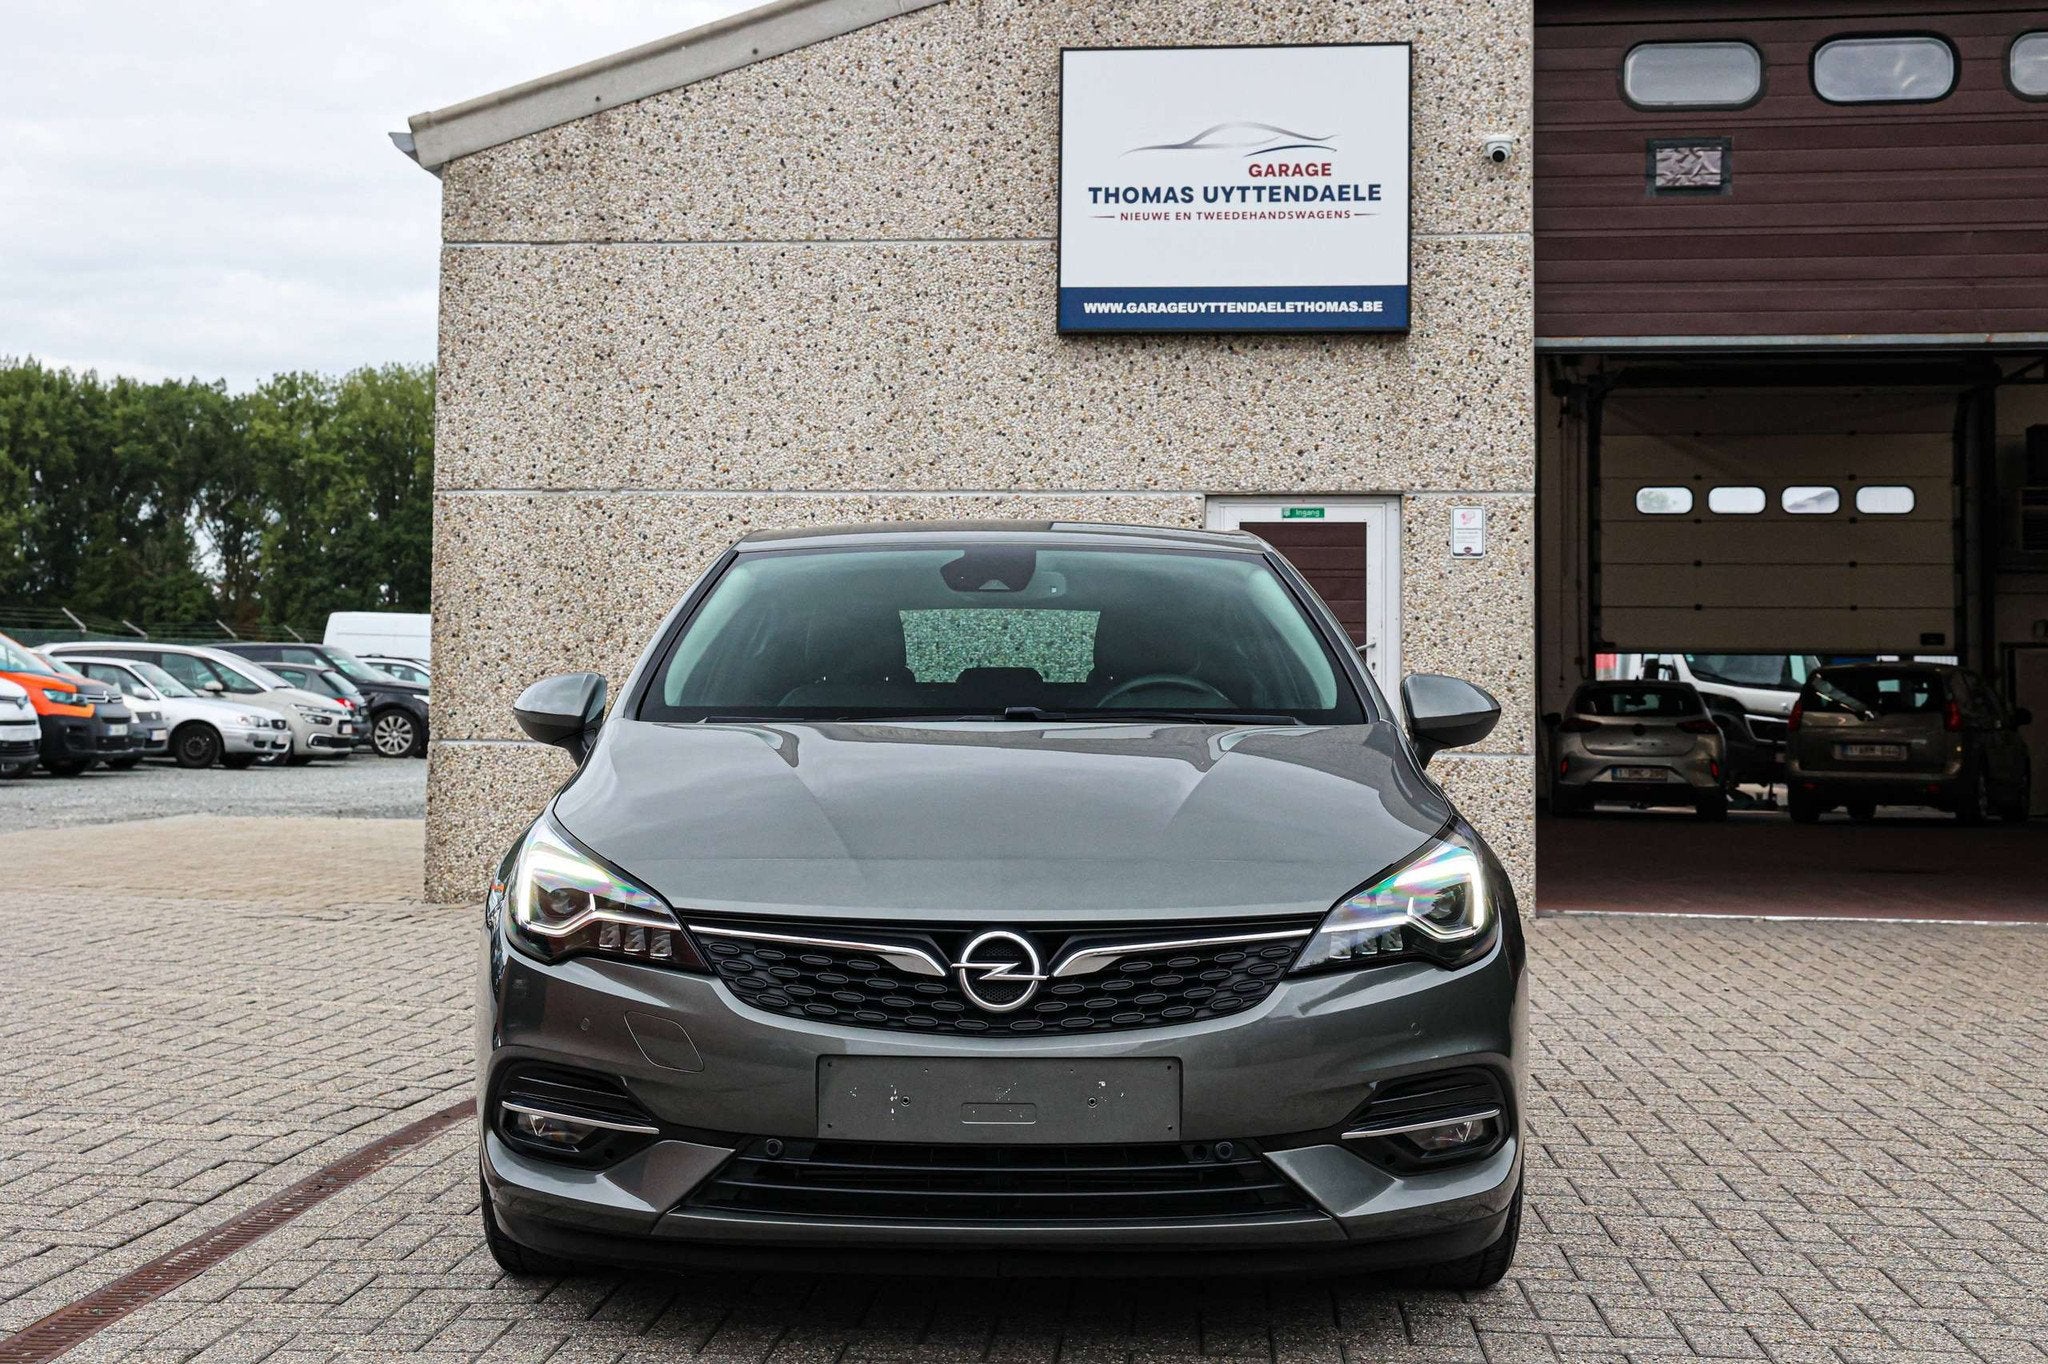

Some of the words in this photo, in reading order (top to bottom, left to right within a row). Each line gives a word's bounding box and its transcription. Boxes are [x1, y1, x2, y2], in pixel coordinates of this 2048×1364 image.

[1248, 162, 1333, 178] GARAGE
[1088, 186, 1195, 205] THOMAS
[1203, 183, 1382, 203] UYTTENDAELE
[1120, 211, 1170, 221] NIEUWE
[1175, 211, 1192, 221] EN
[1196, 209, 1351, 221] TWEEDEHANDSWAGENS
[1083, 300, 1384, 315] WWW.GARAGEUYTTENDAELETHOMAS.BE
[1295, 508, 1320, 517] Ingang
